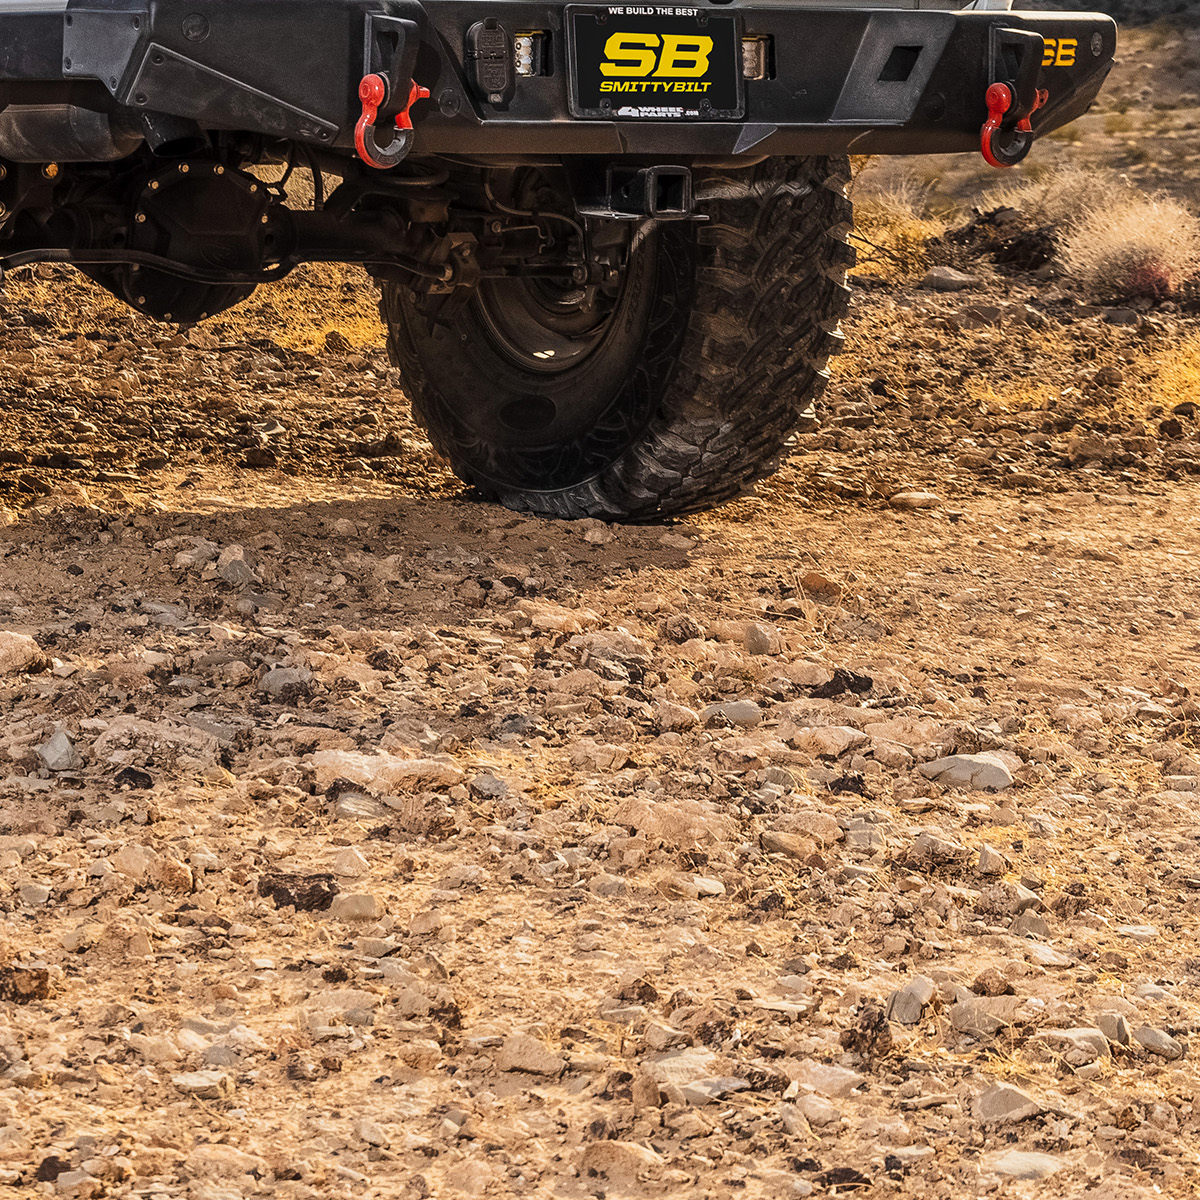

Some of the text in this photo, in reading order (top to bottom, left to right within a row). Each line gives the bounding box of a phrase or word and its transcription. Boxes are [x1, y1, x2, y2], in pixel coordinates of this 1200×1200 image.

[608, 7, 699, 17] WE BUILD THE BEST
[599, 31, 714, 78] SB
[599, 81, 712, 93] SMITTYBILT
